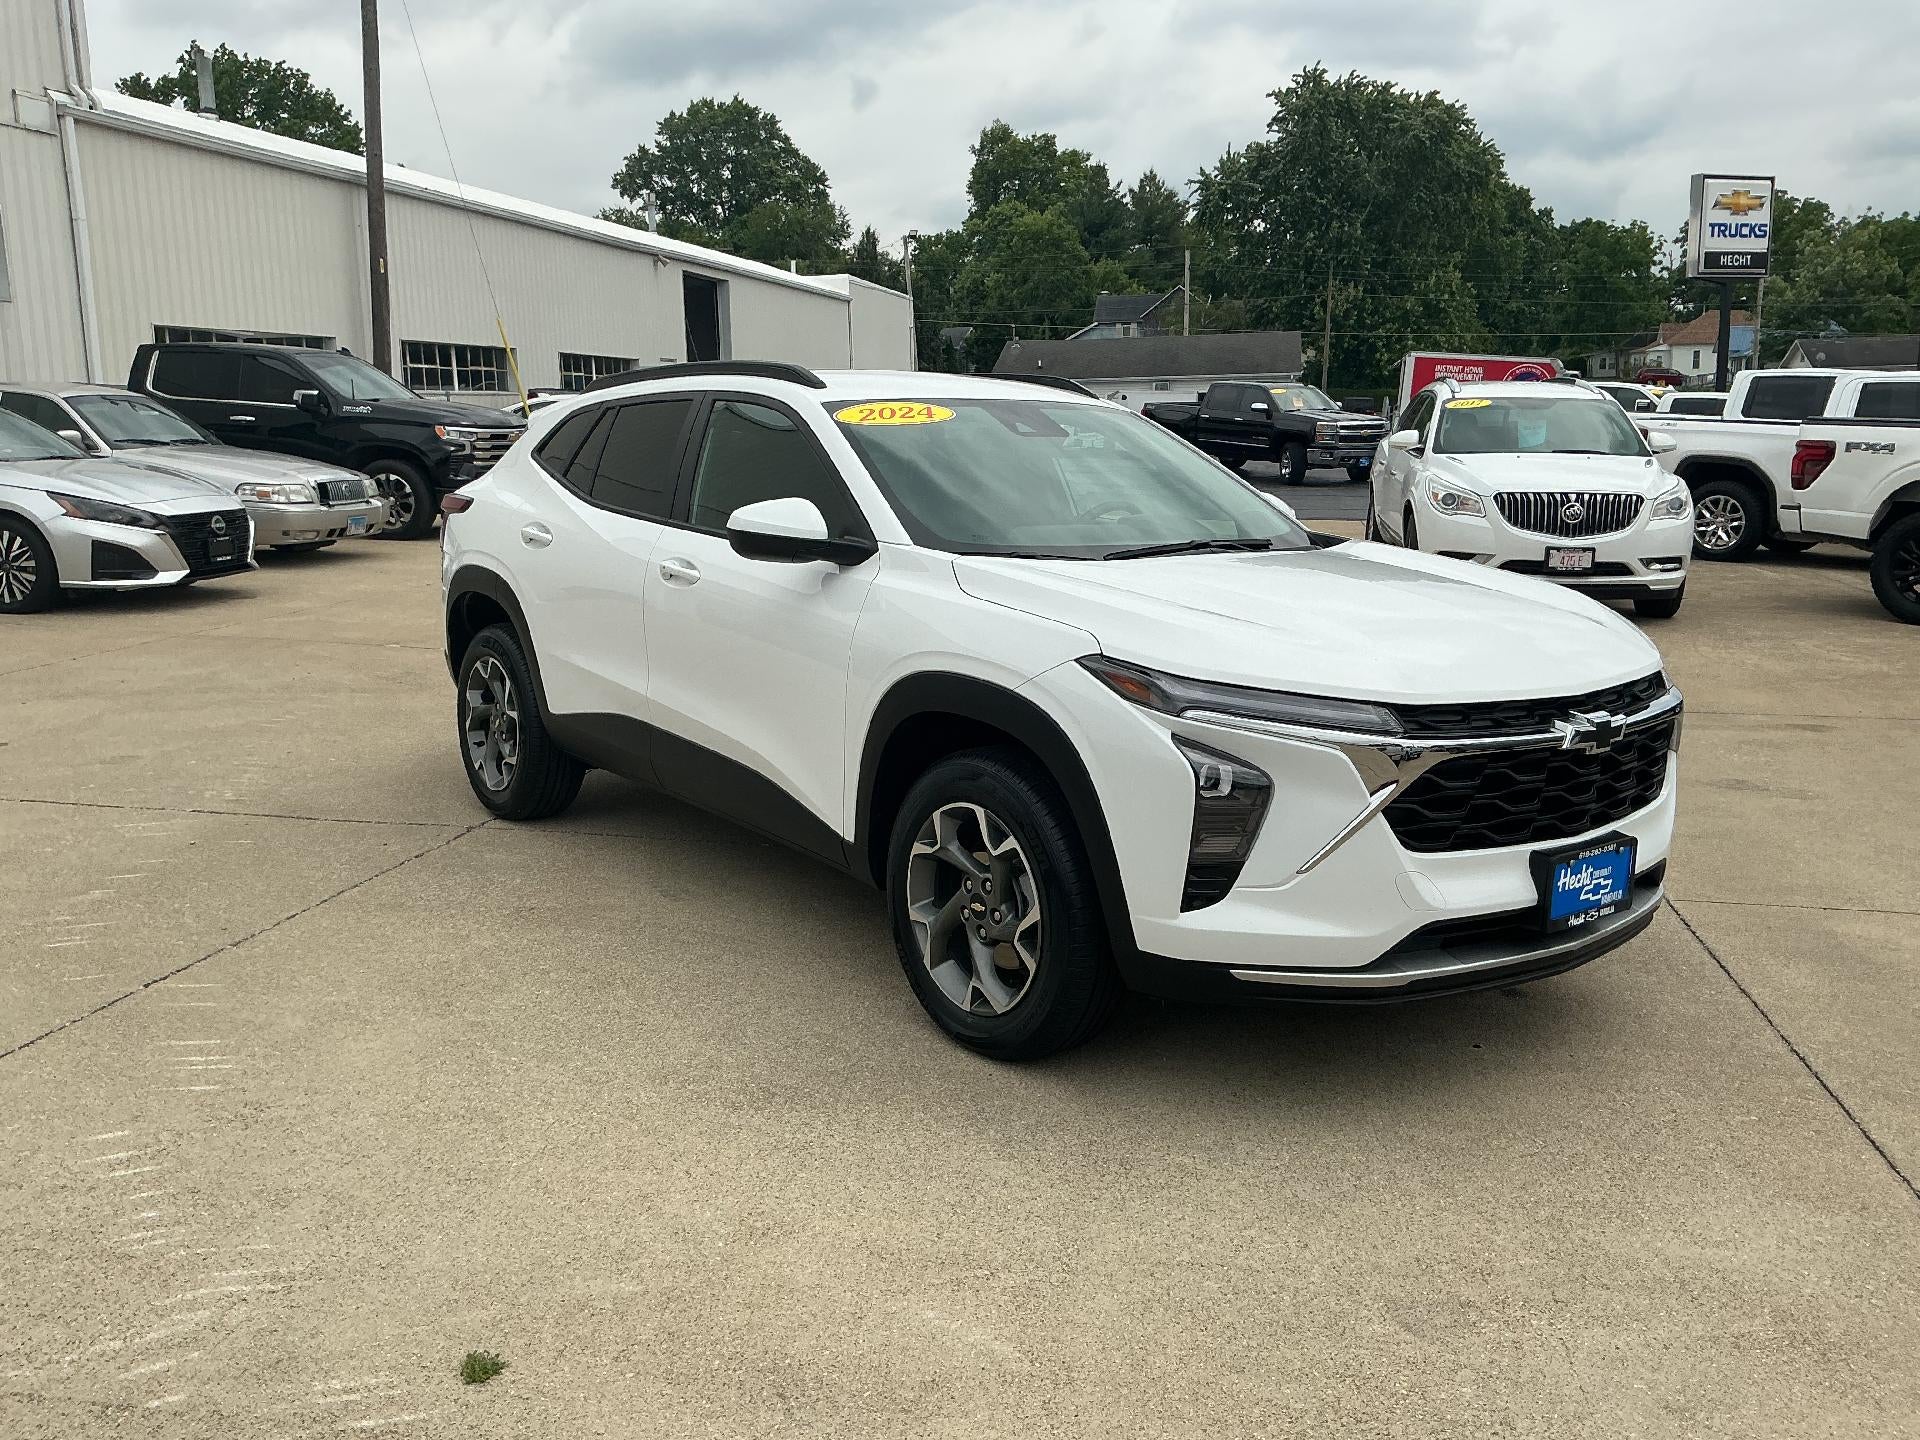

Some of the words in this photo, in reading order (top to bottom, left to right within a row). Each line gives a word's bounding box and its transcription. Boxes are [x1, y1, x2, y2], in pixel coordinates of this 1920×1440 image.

[1709, 223, 1768, 238] TRUCKS
[1720, 254, 1752, 266] HECHT
[1464, 365, 1484, 374] HOME
[858, 406, 937, 422] 2024
[1560, 555, 1576, 567] 475
[1558, 864, 1593, 892] Hecht
[1568, 912, 1586, 927] Hecht
